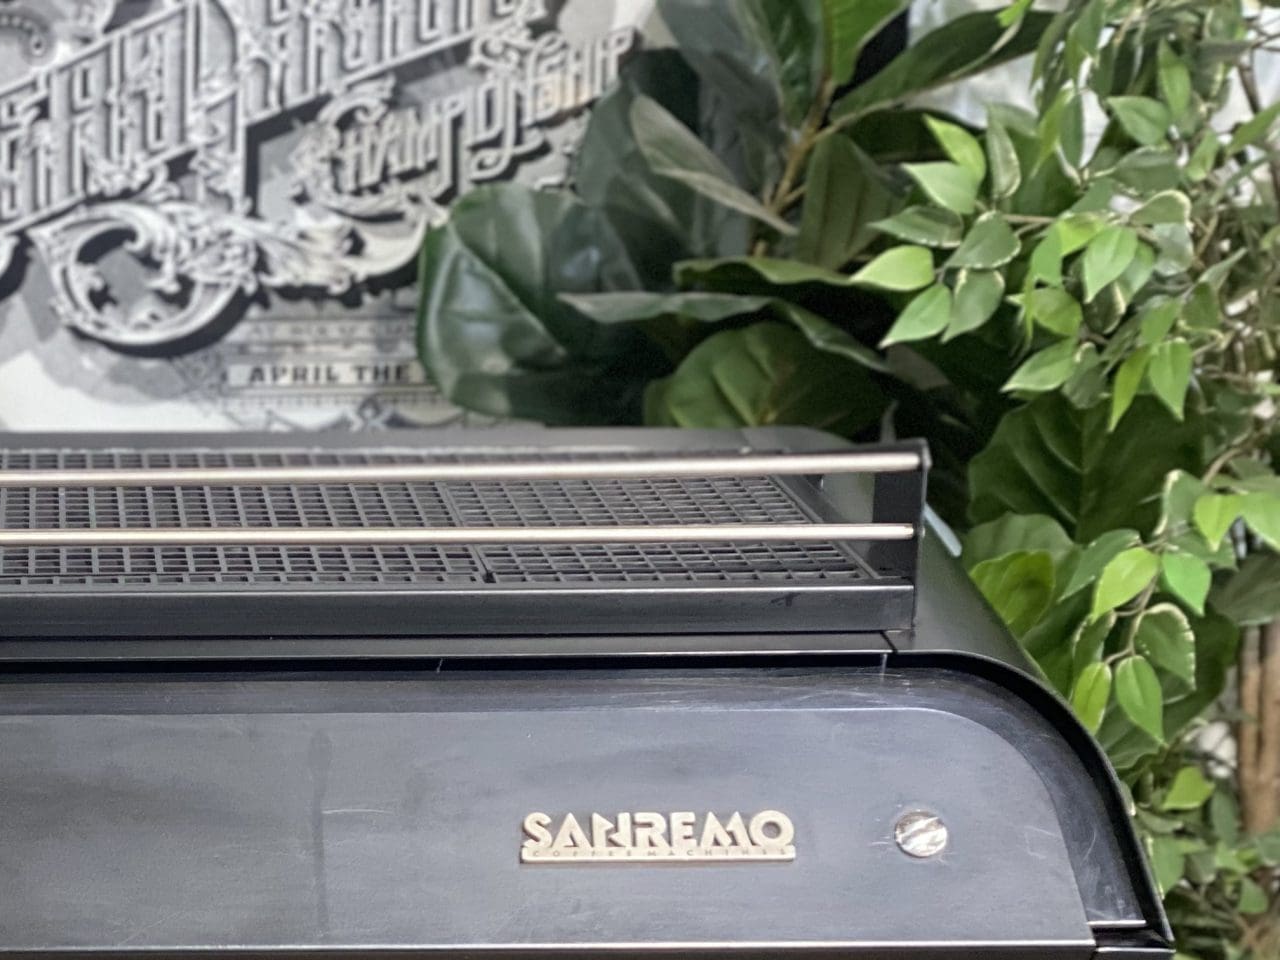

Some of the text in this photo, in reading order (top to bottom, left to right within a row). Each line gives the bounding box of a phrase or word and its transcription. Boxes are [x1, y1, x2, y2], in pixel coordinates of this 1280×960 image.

[248, 363, 412, 383] APRIL THE
[522, 810, 796, 849] SANREMO
[532, 848, 787, 857] COFFEE MACHINES
